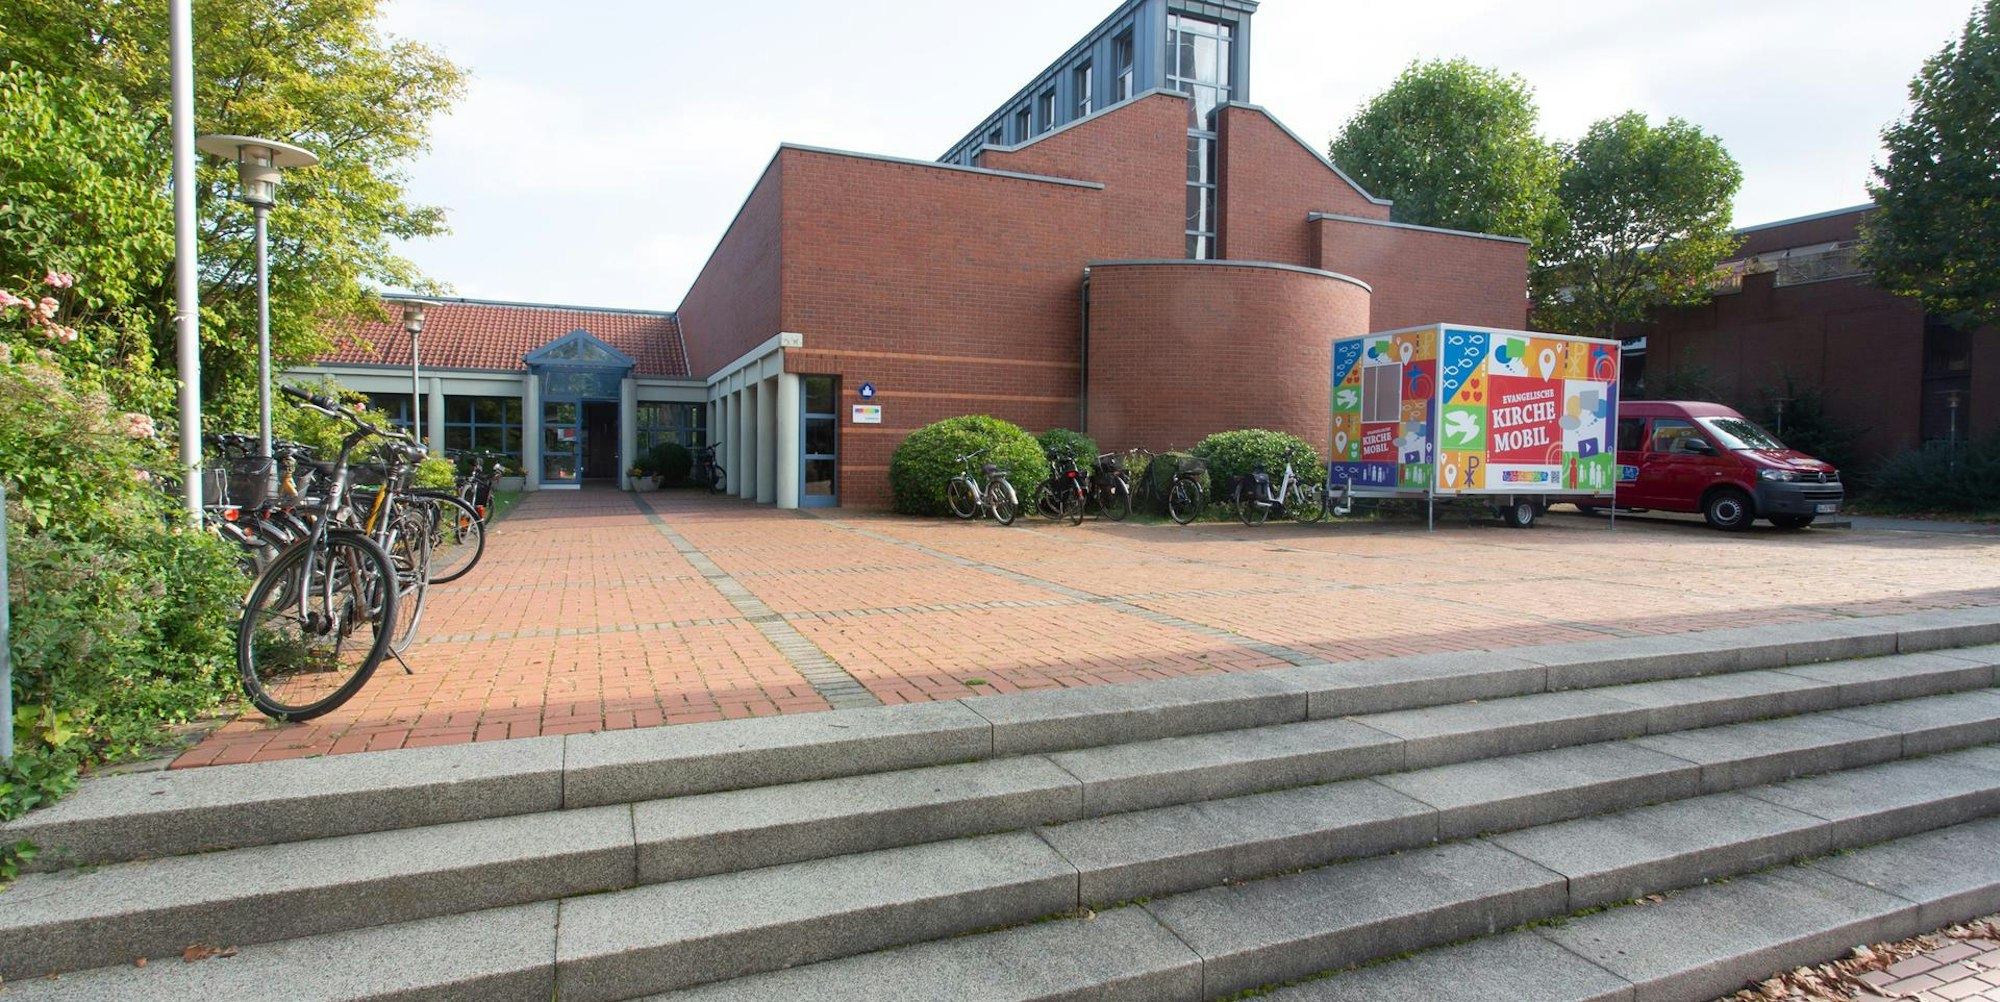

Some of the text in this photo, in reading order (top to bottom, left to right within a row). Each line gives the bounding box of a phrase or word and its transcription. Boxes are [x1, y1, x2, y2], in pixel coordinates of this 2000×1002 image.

[1503, 389, 1554, 404] EVANGELISCHE
[1492, 401, 1556, 428] KIRCHE
[1363, 432, 1392, 445] KIRCHE
[1494, 426, 1549, 452] MOBIL
[1364, 443, 1389, 455] MOBIL
